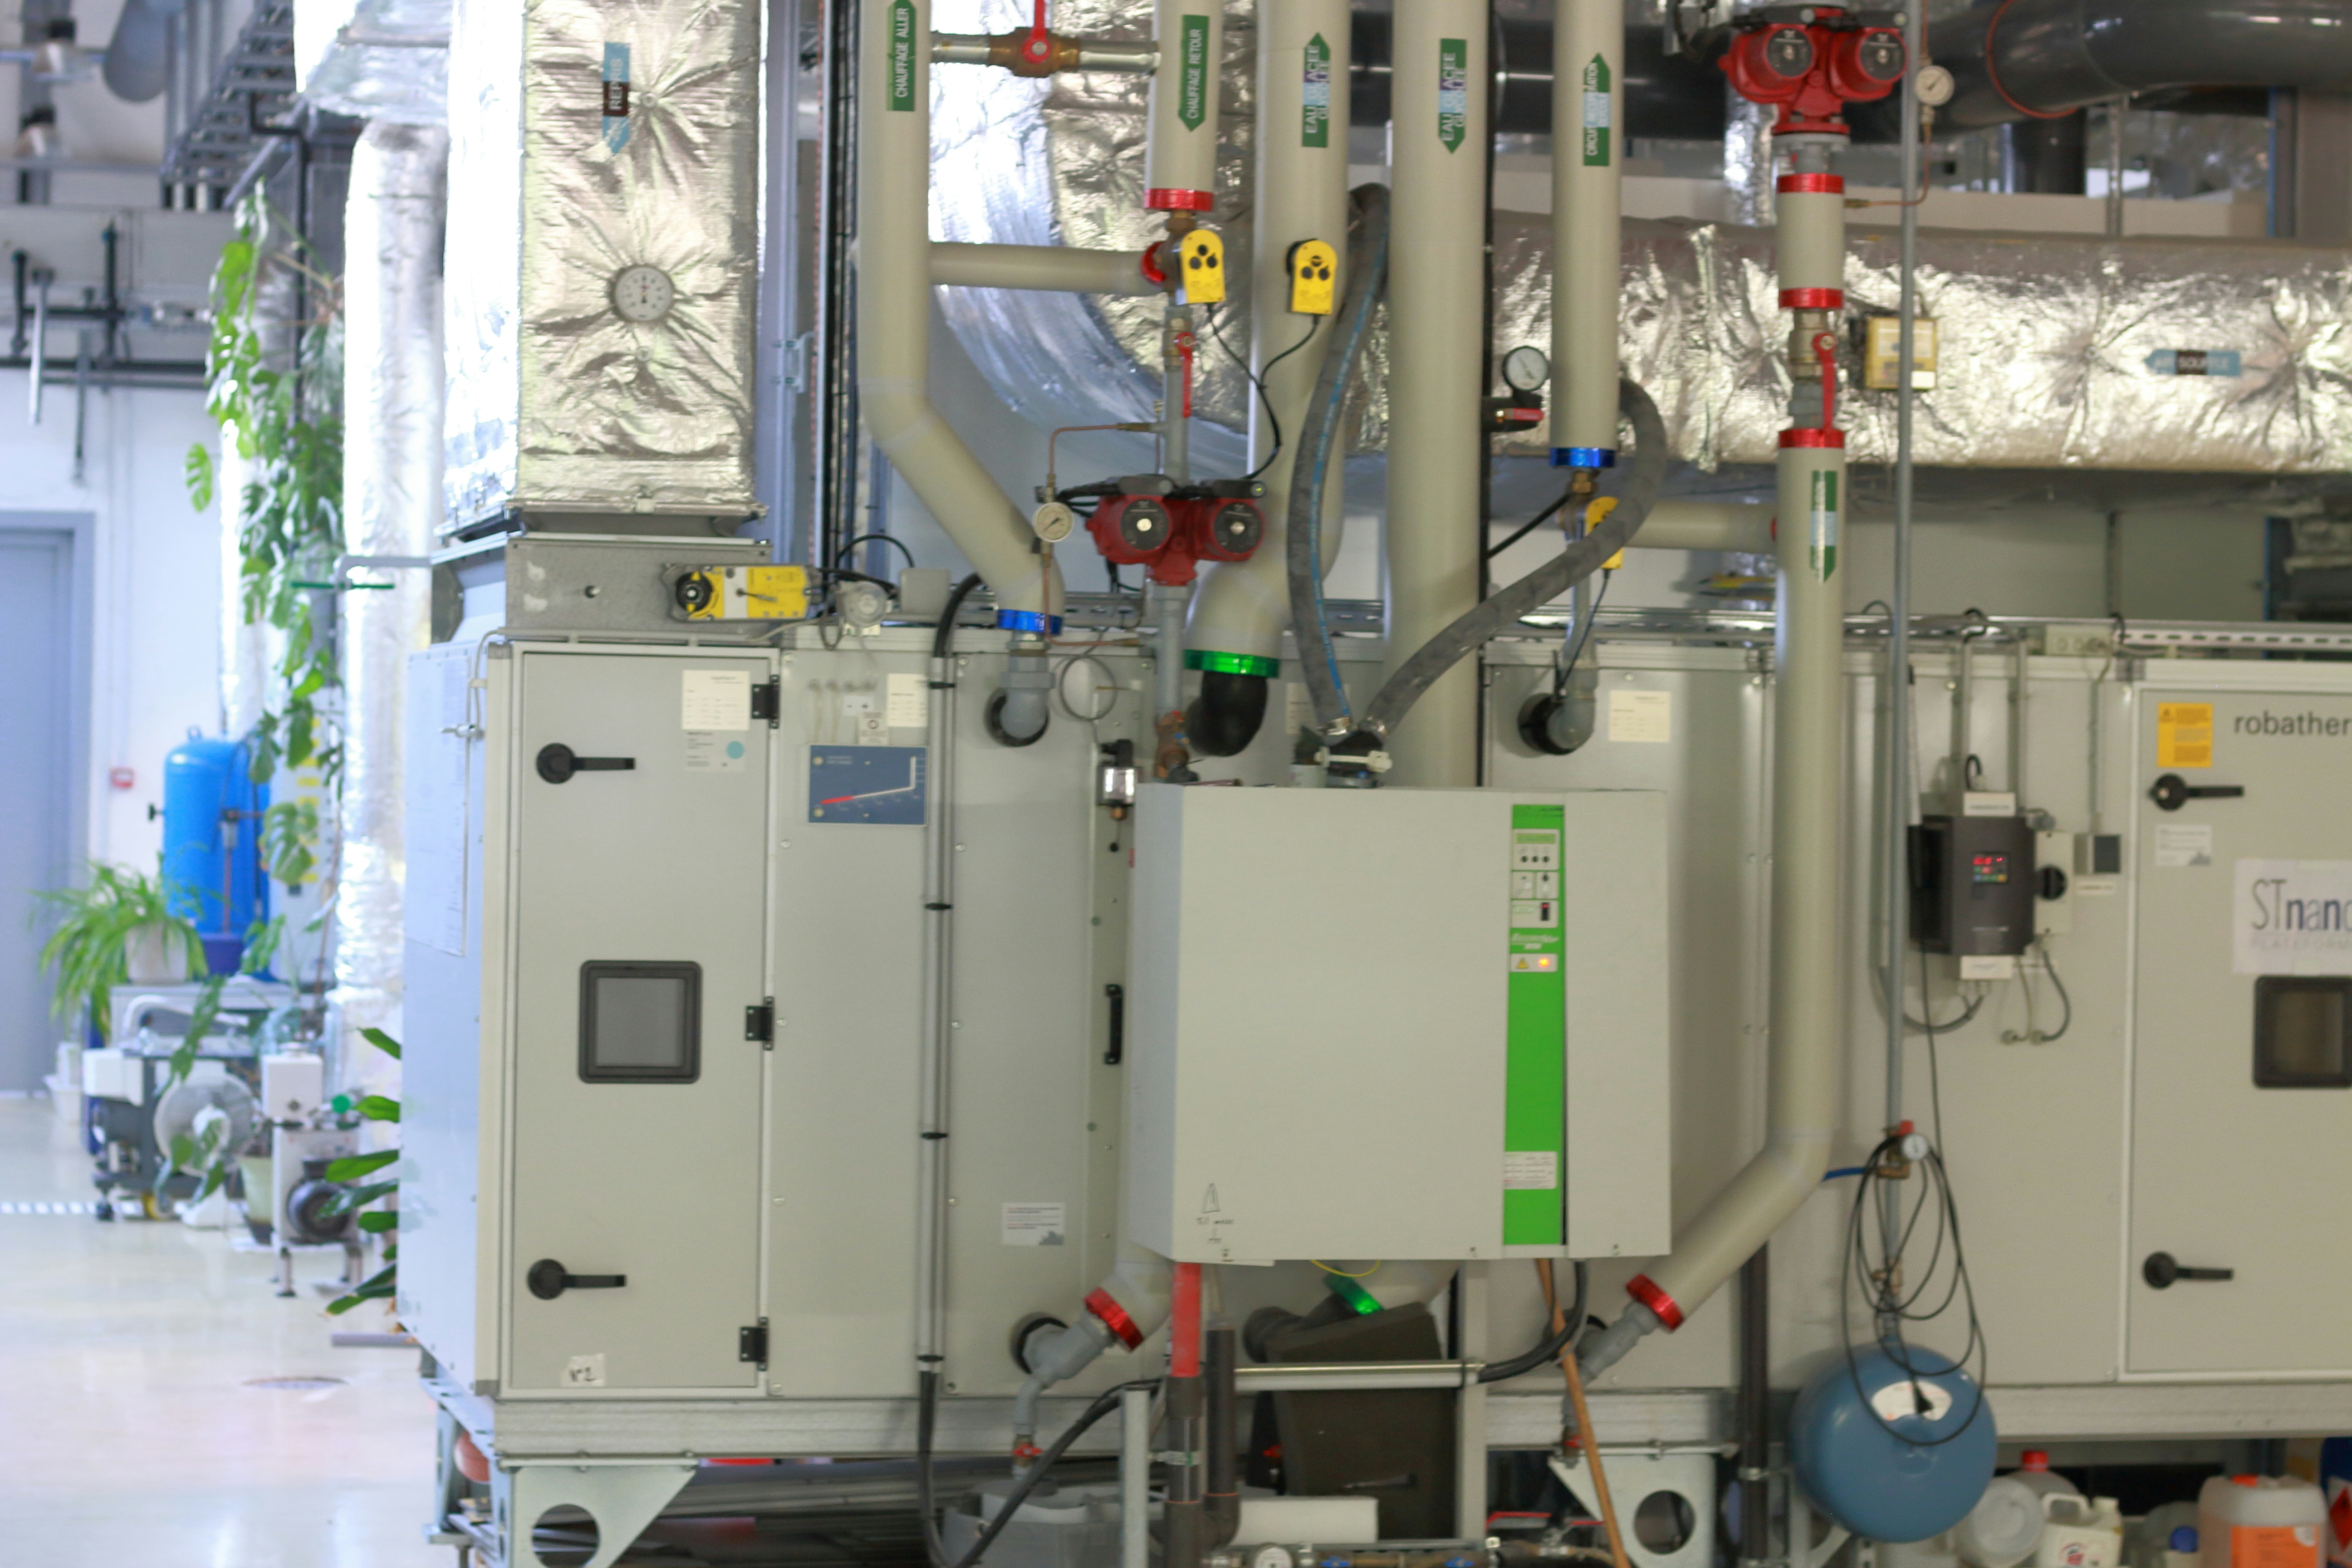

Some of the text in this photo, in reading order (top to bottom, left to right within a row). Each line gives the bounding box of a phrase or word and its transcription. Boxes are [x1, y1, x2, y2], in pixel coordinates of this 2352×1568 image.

[895, 8, 909, 98] CHAUFFAGE ALLER
[1186, 29, 1202, 119] CHAUFFAGE RETOUR
[1305, 106, 1318, 133] EAU
[1441, 114, 1454, 141] EAU
